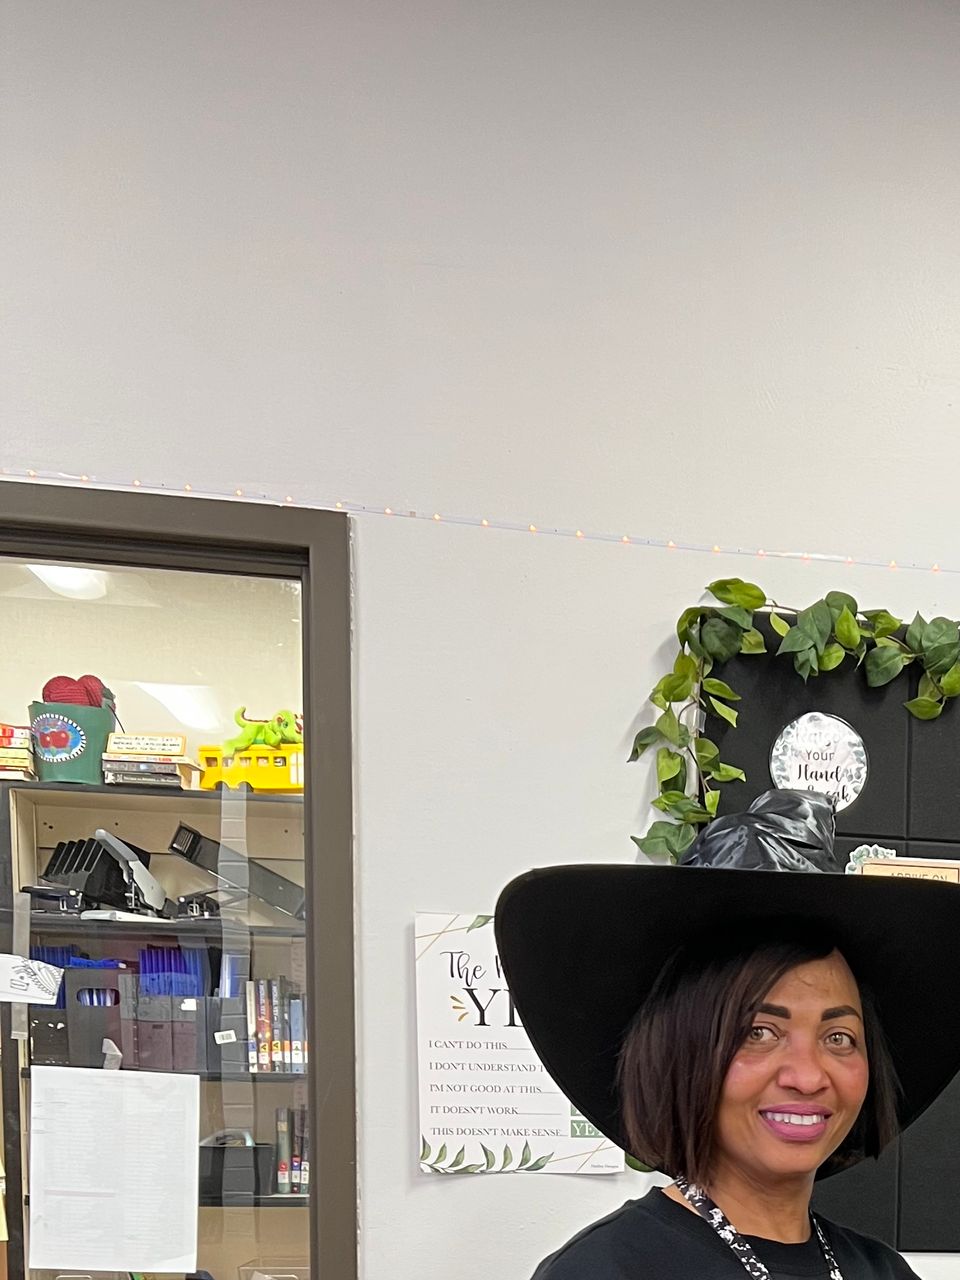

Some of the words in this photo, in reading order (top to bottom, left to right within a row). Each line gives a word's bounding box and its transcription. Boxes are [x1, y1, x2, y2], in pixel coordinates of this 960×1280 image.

[440, 951, 487, 987] The
[428, 1040, 432, 1048] I
[434, 1040, 464, 1048] CAN'T
[483, 1041, 508, 1050] THIS
[429, 1062, 433, 1070] I
[435, 1062, 466, 1071] DON'T
[468, 1063, 536, 1072] UNDERSTAND
[430, 1084, 444, 1092] I'M
[446, 1084, 467, 1093] NOT
[470, 1085, 502, 1093] GOOD
[504, 1086, 517, 1094] AT
[519, 1086, 542, 1094] THIS
[430, 1106, 440, 1114] IT
[443, 1106, 486, 1114] DOESN'T
[487, 1106, 518, 1115] WORK
[431, 1128, 454, 1136] THIS
[456, 1128, 499, 1136] DOESN'T
[500, 1128, 530, 1137] MAKE
[532, 1129, 560, 1137] SENSE
